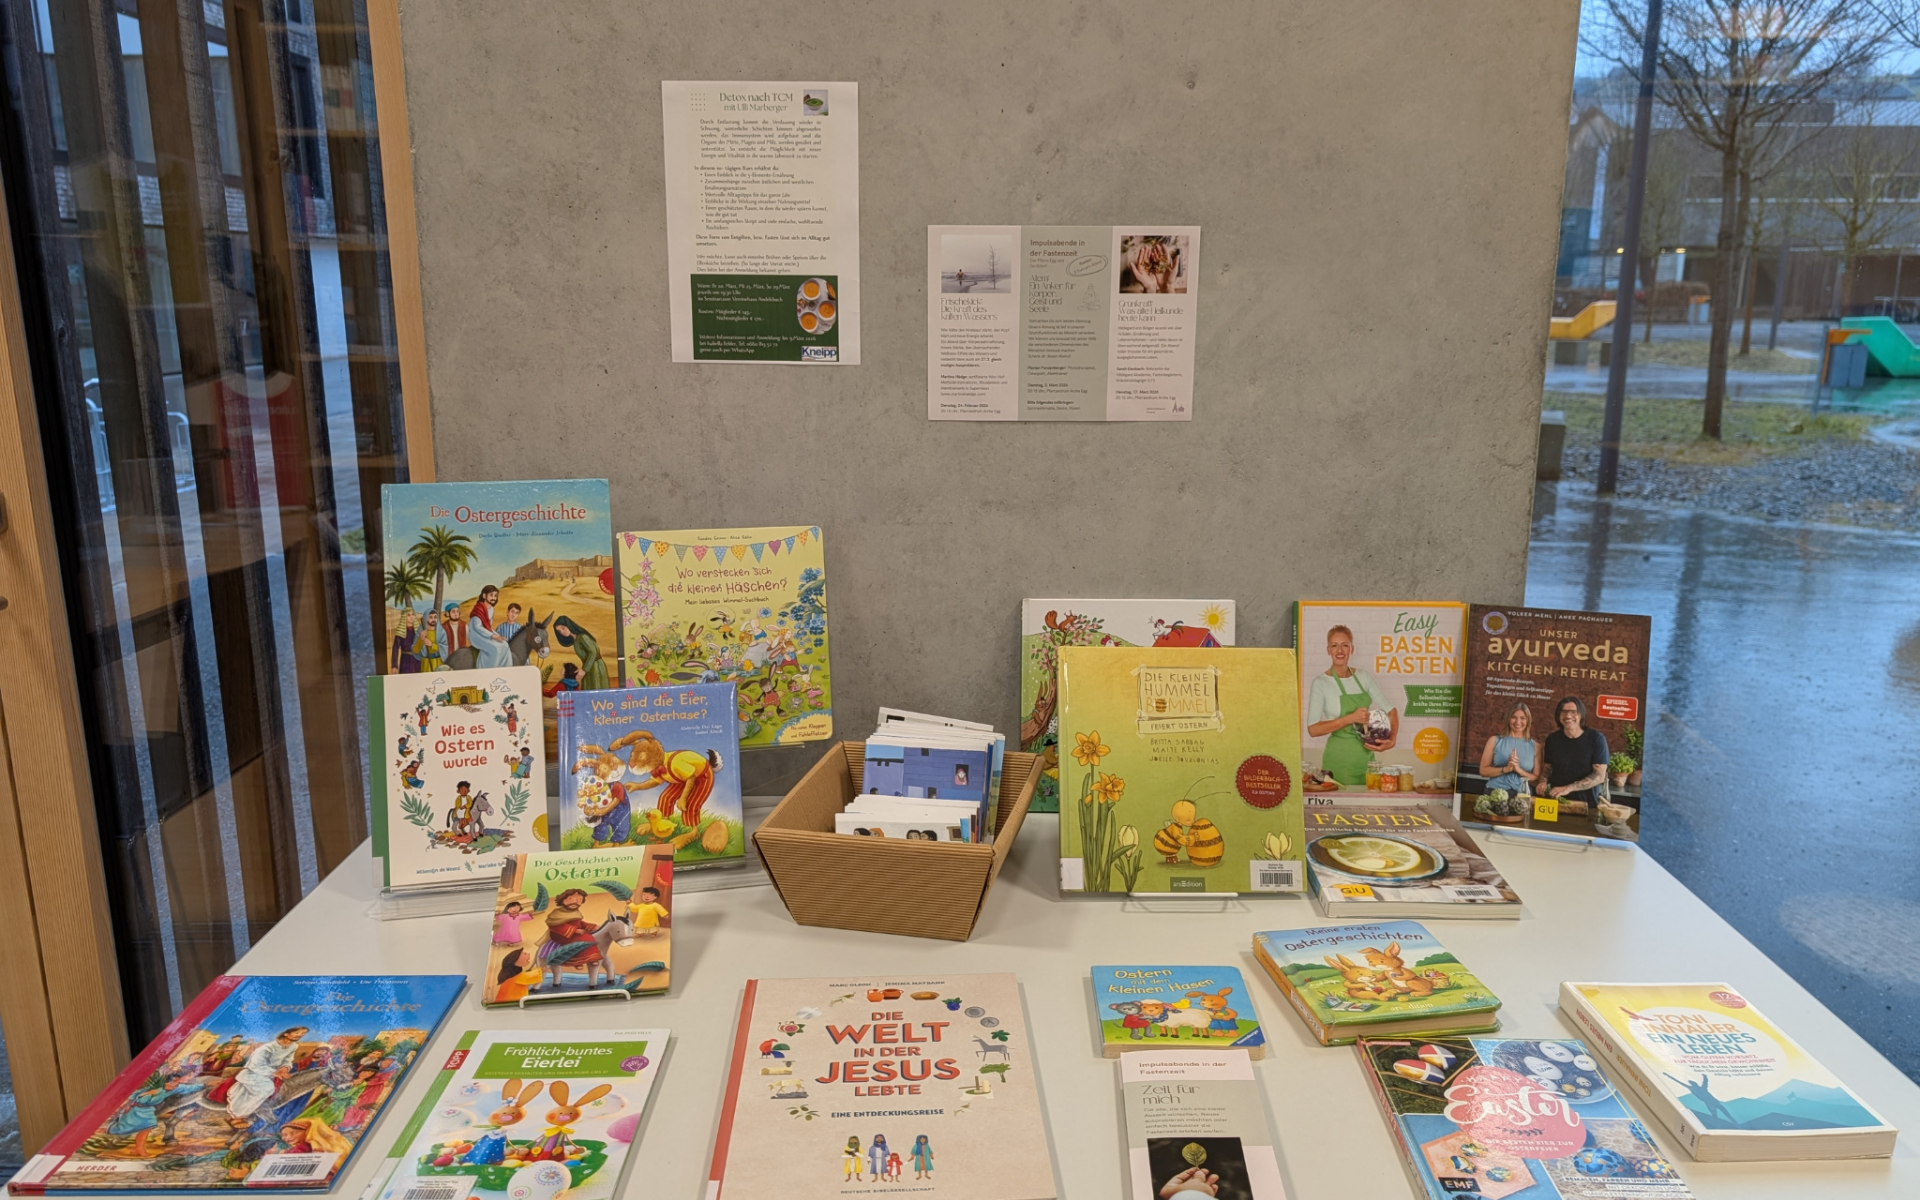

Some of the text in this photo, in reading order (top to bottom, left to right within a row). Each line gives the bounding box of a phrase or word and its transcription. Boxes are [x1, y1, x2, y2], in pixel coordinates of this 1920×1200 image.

[719, 92, 793, 102] Detox nach TCM
[724, 103, 787, 113] mit Ulli Marberger
[1029, 239, 1077, 247] Impulsabende
[801, 346, 836, 358] Kneipp
[430, 502, 587, 529] Die Ostergeschichte
[675, 565, 772, 579] Wo verstecken sich
[667, 575, 787, 594] die kleinen Häschen?
[1393, 611, 1439, 638] Easy
[1539, 629, 1577, 639] UNSER
[1380, 635, 1452, 654] BASEN
[1487, 636, 1628, 664] ayurveda
[1374, 655, 1457, 674] FASTEN
[1487, 661, 1627, 681] KITCHEN RETREAT
[1144, 672, 1208, 682] DIE KLEINE
[1144, 683, 1210, 697] HUMMEL
[591, 690, 708, 711] Wo sind die Eier,
[640, 708, 708, 722] Osterhase?
[441, 723, 486, 736] Wie es
[1178, 721, 1208, 729] OSTERN
[434, 739, 495, 755] Ostern
[1175, 738, 1205, 746] SABBAG
[1181, 745, 1205, 753] KELLY
[443, 755, 488, 769] wurde
[1245, 781, 1281, 789] BESTSELLER
[1311, 813, 1433, 826] FASTEN
[534, 860, 552, 868] Die
[555, 856, 611, 867] Geschichte
[544, 865, 620, 881] Ostern
[1173, 880, 1203, 888] arsEdition
[1305, 924, 1381, 937] Meine ersten
[1284, 931, 1424, 952] Ostergeschichten
[1114, 967, 1173, 980] Ostern
[1168, 977, 1215, 992] Hasen
[325, 991, 356, 1002] Die
[240, 999, 422, 1017] Ostergeschichte
[871, 1011, 904, 1022] DIE
[1652, 1014, 1708, 1024] TONI
[825, 1021, 951, 1045] WELT
[1642, 1023, 1741, 1034] INNAUER
[1645, 1032, 1757, 1044] EIN NEUES
[504, 1045, 613, 1057] Fröhlich-buntes
[854, 1046, 922, 1058] IN DER
[1677, 1043, 1746, 1055] LEBEN
[446, 1051, 464, 1070] TOPP
[521, 1056, 580, 1070] Eierlei
[815, 1058, 961, 1085] JESUS
[854, 1084, 922, 1097] LEBTE
[1141, 1083, 1200, 1095] Zeit für
[1142, 1094, 1181, 1105] mich
[1442, 1083, 1579, 1127] Easter
[831, 1108, 945, 1119] EINE ENTDECKUNGSREISE
[76, 1164, 117, 1172] HERDER
[1443, 1180, 1473, 1190] EMF
